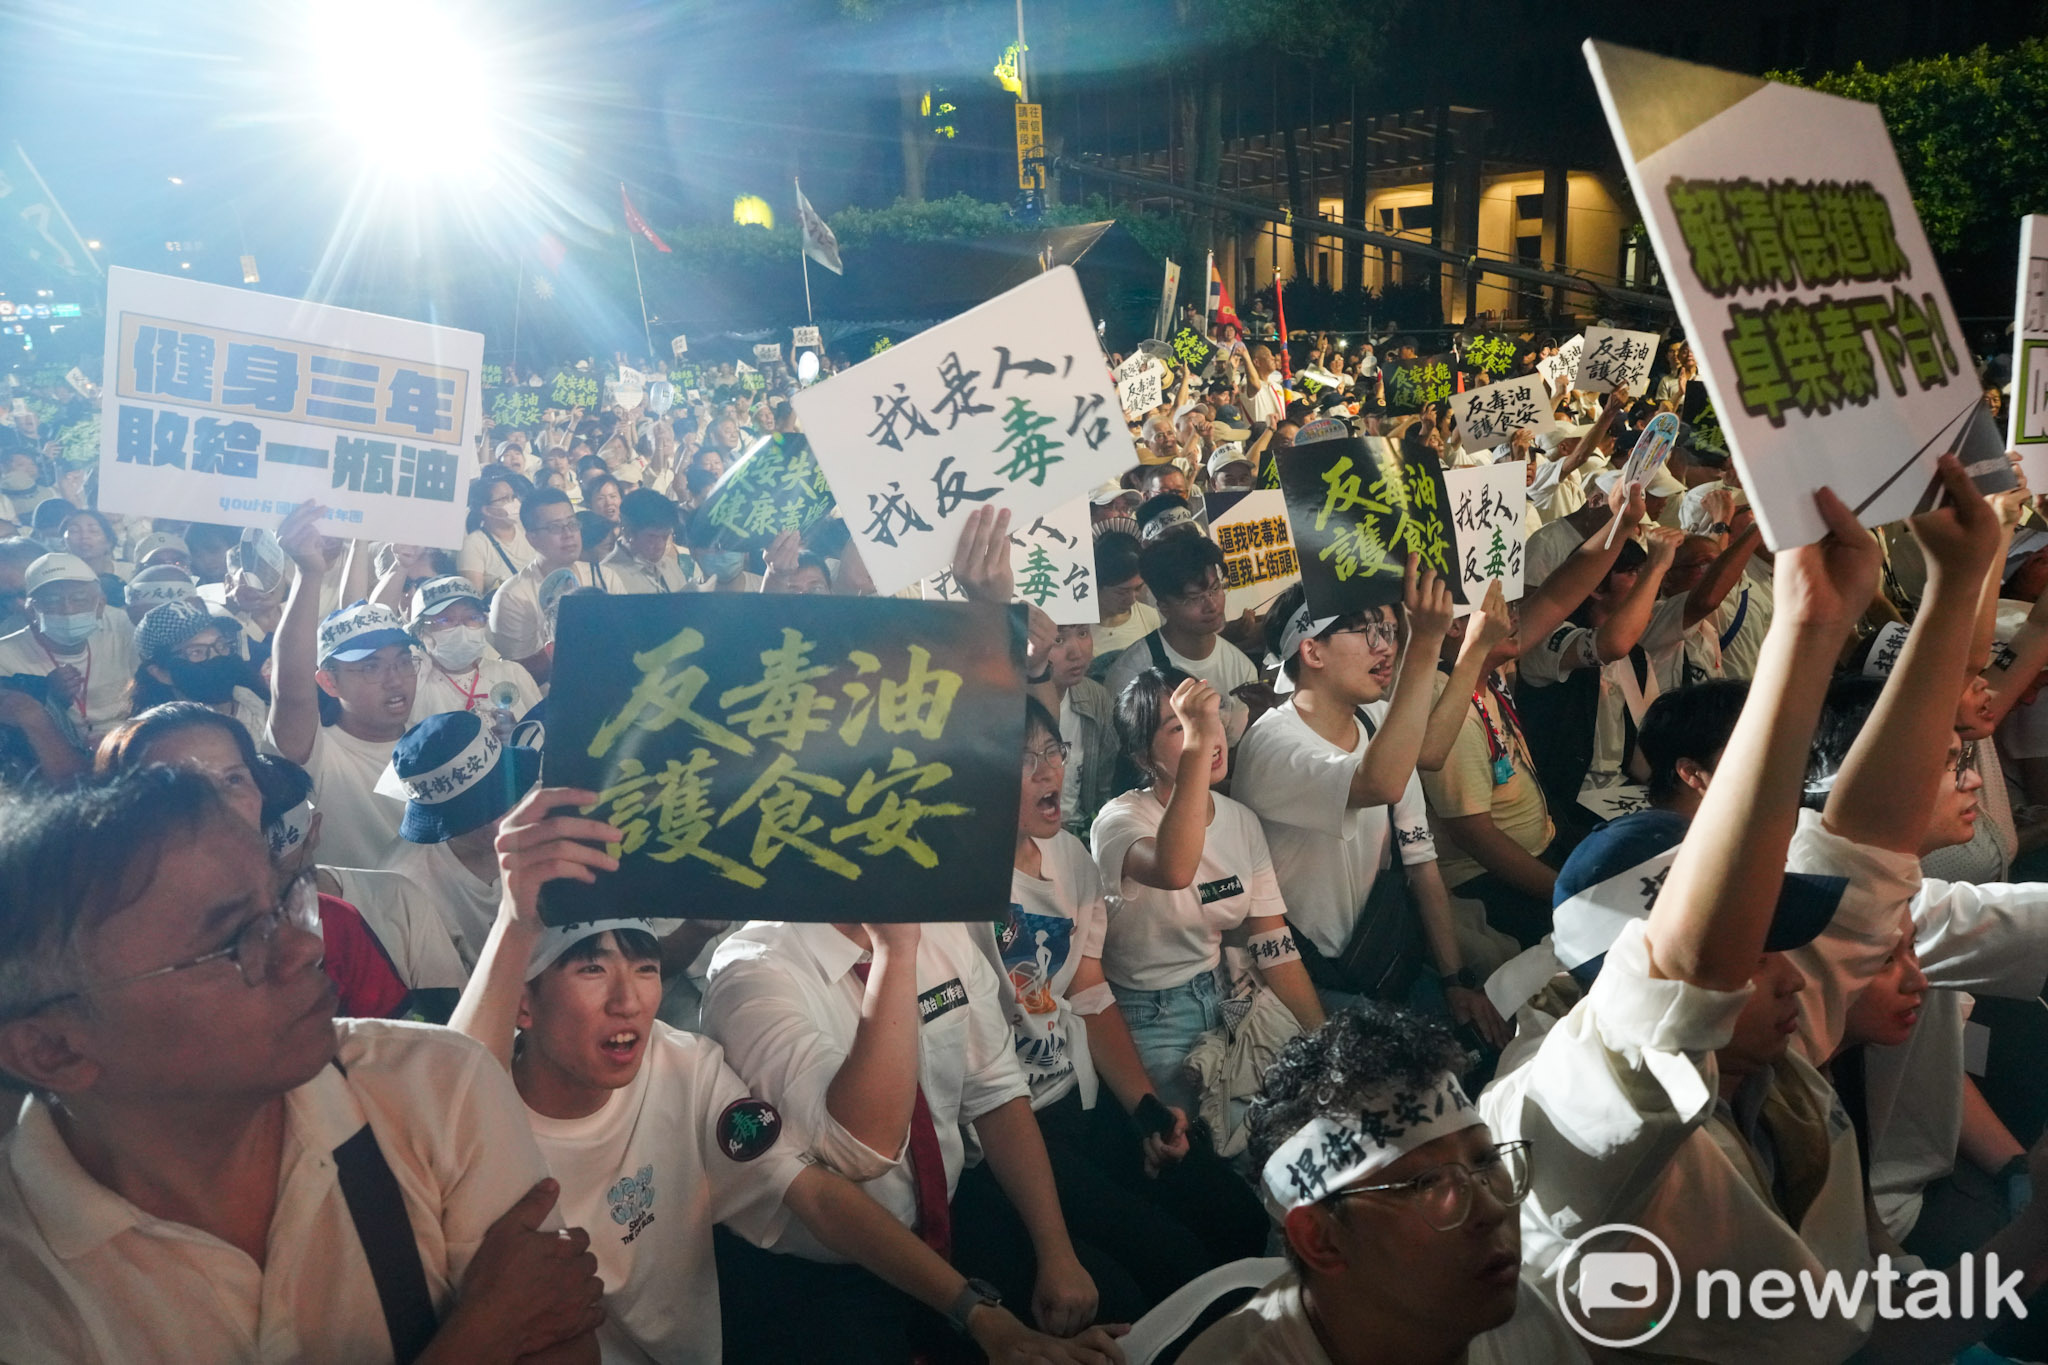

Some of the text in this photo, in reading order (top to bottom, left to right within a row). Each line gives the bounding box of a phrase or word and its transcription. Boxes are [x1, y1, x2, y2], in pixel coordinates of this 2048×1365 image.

[1666, 176, 1911, 297] 賴清德道歉
[1465, 350, 1513, 375] 護食安
[1467, 335, 1517, 357] 反毒油
[1589, 336, 1650, 361] 反毒油
[133, 325, 455, 435] 健身三年
[1390, 362, 1451, 388] 食安失能
[1586, 360, 1644, 387] 護食安
[1466, 386, 1531, 422] 反毒油
[1468, 404, 1543, 440] 護食安
[115, 404, 459, 502] 敗給一瓶油
[862, 393, 1111, 547] 我反毒台
[1314, 454, 1437, 531] 反毒油
[1217, 517, 1289, 553] 逼我吃毒油
[1318, 511, 1450, 582] 護食安
[1464, 524, 1522, 584] 反毒台
[1224, 549, 1299, 589] 逼我上街頭!
[587, 627, 963, 758] 反毒油
[579, 747, 977, 889] 護食安
